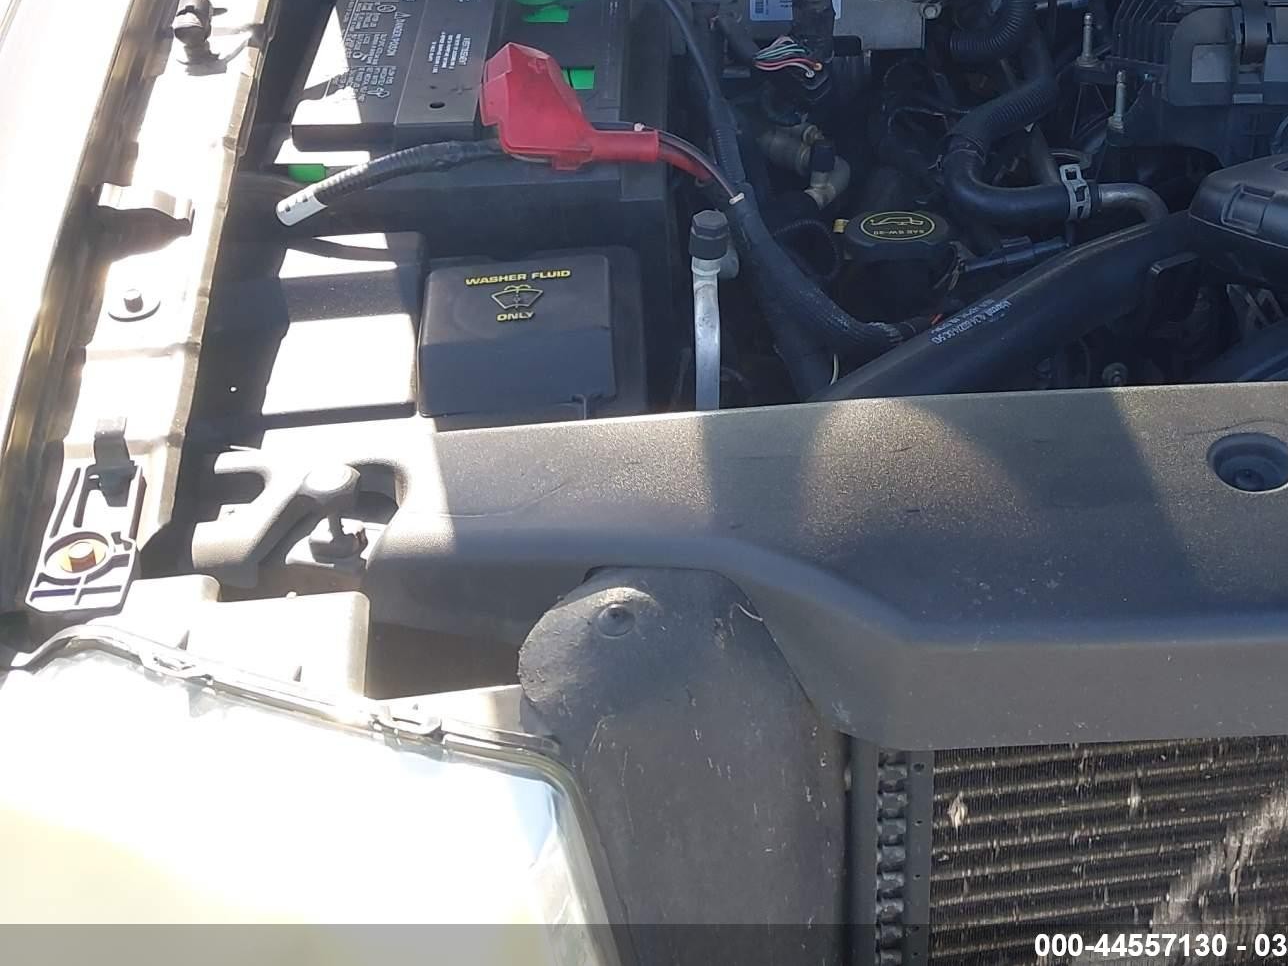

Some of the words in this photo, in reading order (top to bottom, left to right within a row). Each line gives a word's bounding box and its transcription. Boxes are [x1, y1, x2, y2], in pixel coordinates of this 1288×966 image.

[465, 273, 527, 286] WASHER
[531, 270, 571, 280] FLUID
[496, 311, 534, 322] ONLY
